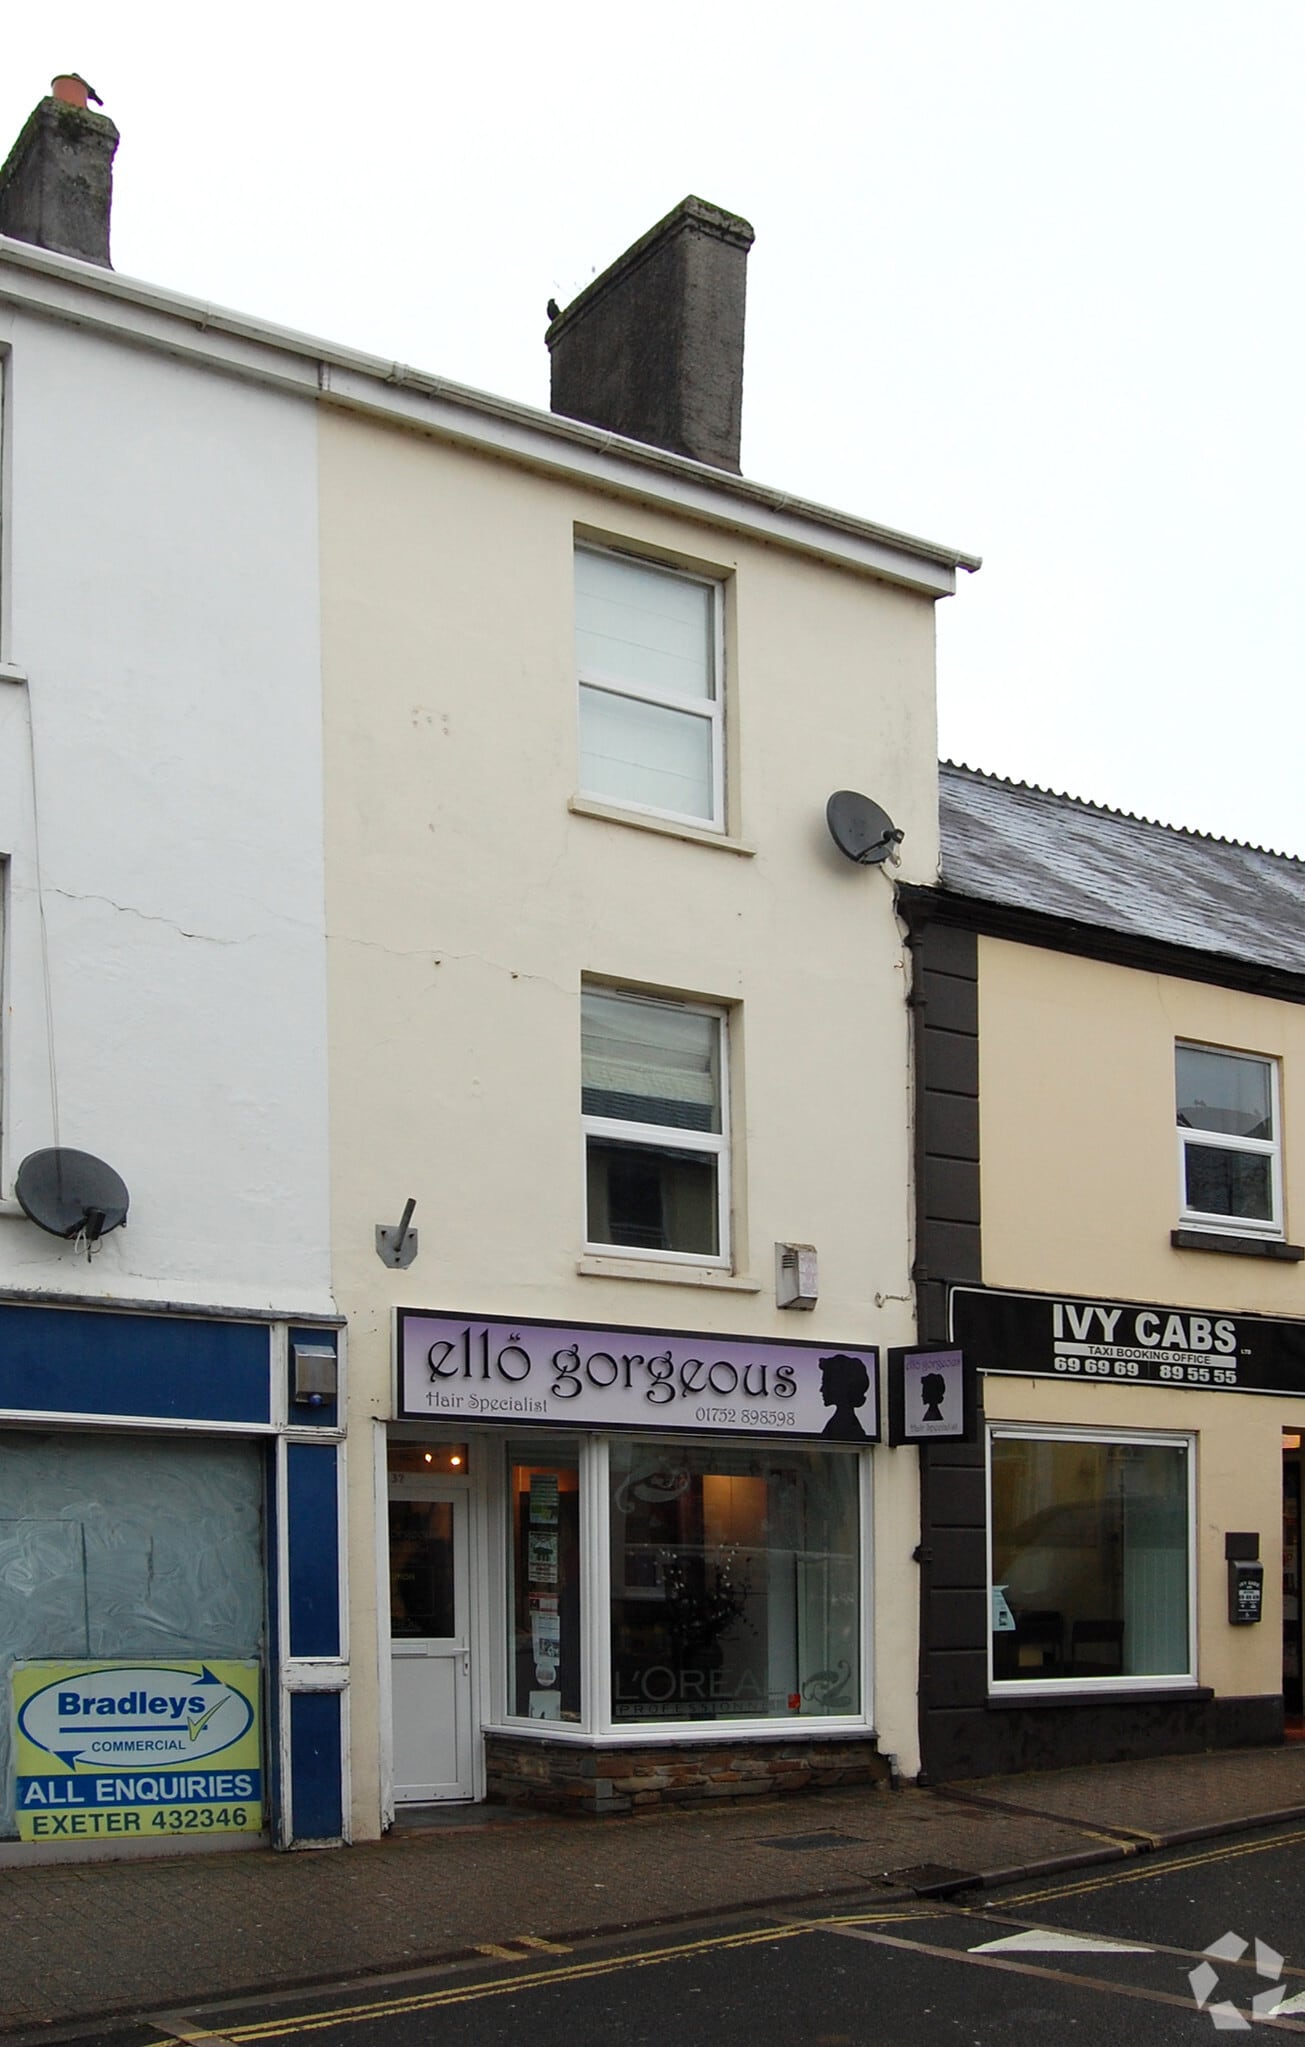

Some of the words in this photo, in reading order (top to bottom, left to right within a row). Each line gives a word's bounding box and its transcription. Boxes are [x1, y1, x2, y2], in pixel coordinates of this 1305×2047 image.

[1053, 1304, 1122, 1342] IVY
[1135, 1312, 1237, 1353] CABS
[1088, 1346, 1113, 1356] TAXI
[1116, 1348, 1169, 1361] BOOKING
[1172, 1353, 1211, 1364] OFFICE
[551, 1343, 797, 1404] gorgeous
[1054, 1357, 1080, 1372] 69
[1085, 1359, 1110, 1374] 69
[1114, 1361, 1139, 1376] 69
[1160, 1365, 1184, 1379] 89
[1187, 1367, 1210, 1382] 55
[1213, 1370, 1237, 1384] 55
[426, 1392, 464, 1408] Hair
[468, 1394, 547, 1412] Specialist
[695, 1407, 736, 1422] 01752
[741, 1410, 795, 1426] 898598
[58, 1692, 206, 1719] Bradleys
[620, 1702, 779, 1714] PROFESSIONN
[91, 1740, 186, 1752] COMMERCIAL
[24, 1780, 85, 1804] ALL
[96, 1774, 253, 1802] ENQUIRIES
[33, 1812, 141, 1835] EXETER
[151, 1807, 248, 1830] 432346
